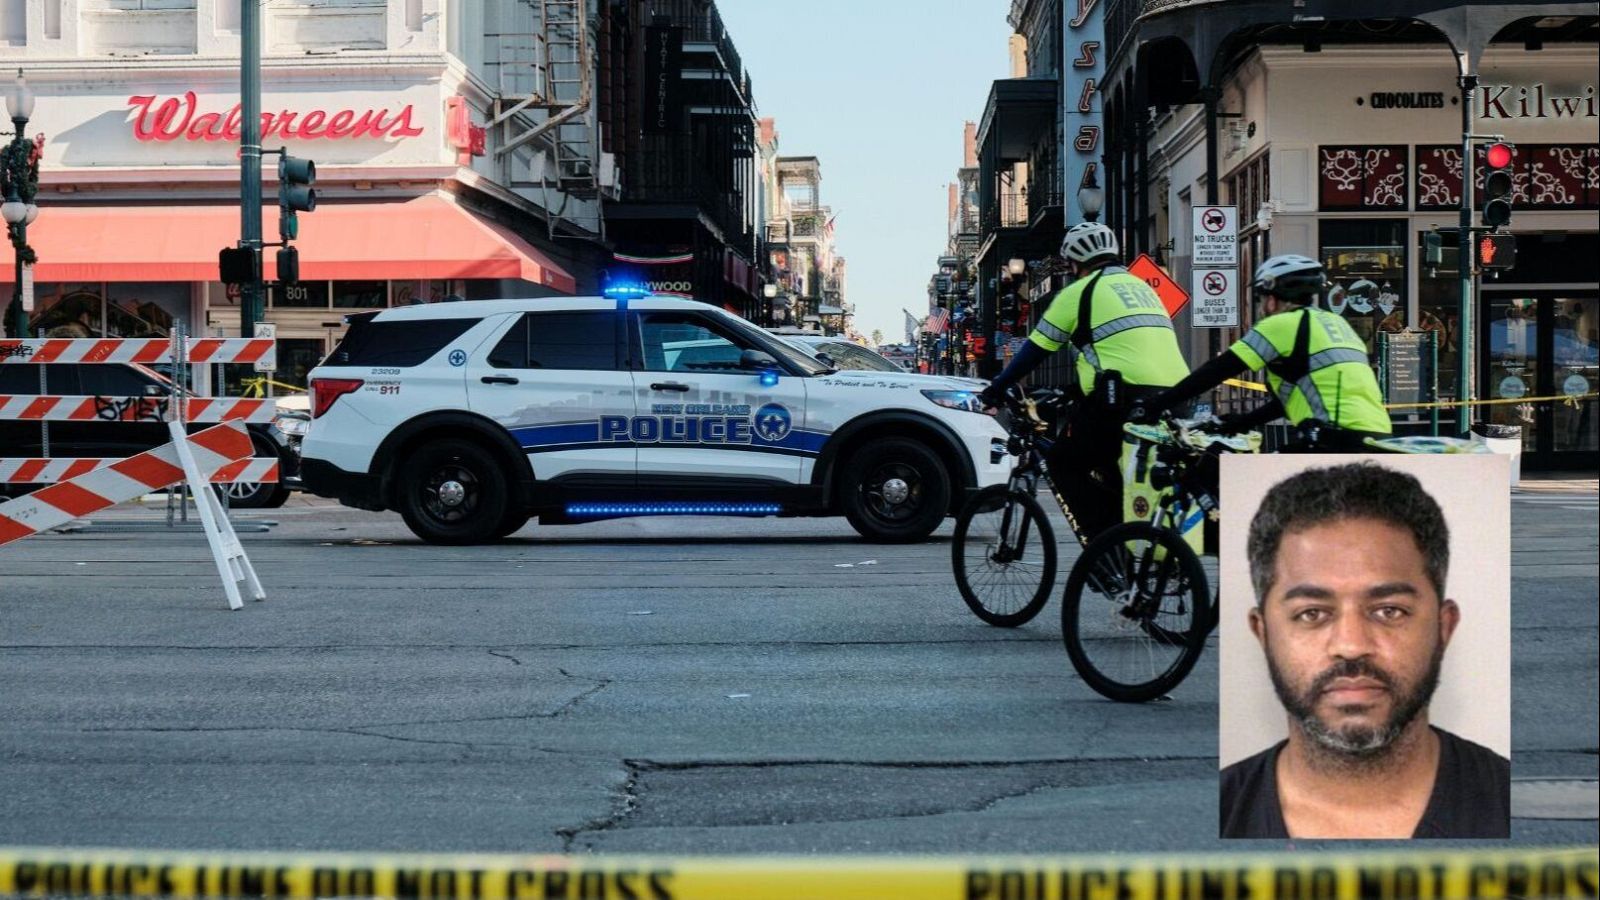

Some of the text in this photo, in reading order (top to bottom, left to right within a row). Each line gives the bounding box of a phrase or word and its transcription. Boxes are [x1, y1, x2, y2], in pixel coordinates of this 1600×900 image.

[656, 31, 669, 128] HYATT CENTRIC
[1371, 92, 1444, 109] CHOCOLATES
[1194, 234, 1236, 243] NO TRUCKS
[286, 286, 308, 300] 801
[1204, 298, 1226, 307] BUSES
[1194, 306, 1211, 314] LONGER
[1211, 306, 1223, 314] THAN
[371, 368, 401, 376] 23209
[380, 385, 400, 395] 911
[651, 403, 752, 415] NEW ORLEANS
[599, 415, 753, 445] POLICE
[13, 862, 675, 900] POLICE LINE DO NOT CROSS
[963, 868, 1151, 900] POLICE
[1155, 868, 1252, 900] LINE
[1274, 867, 1338, 900] DO
[1356, 865, 1446, 900] NOT
